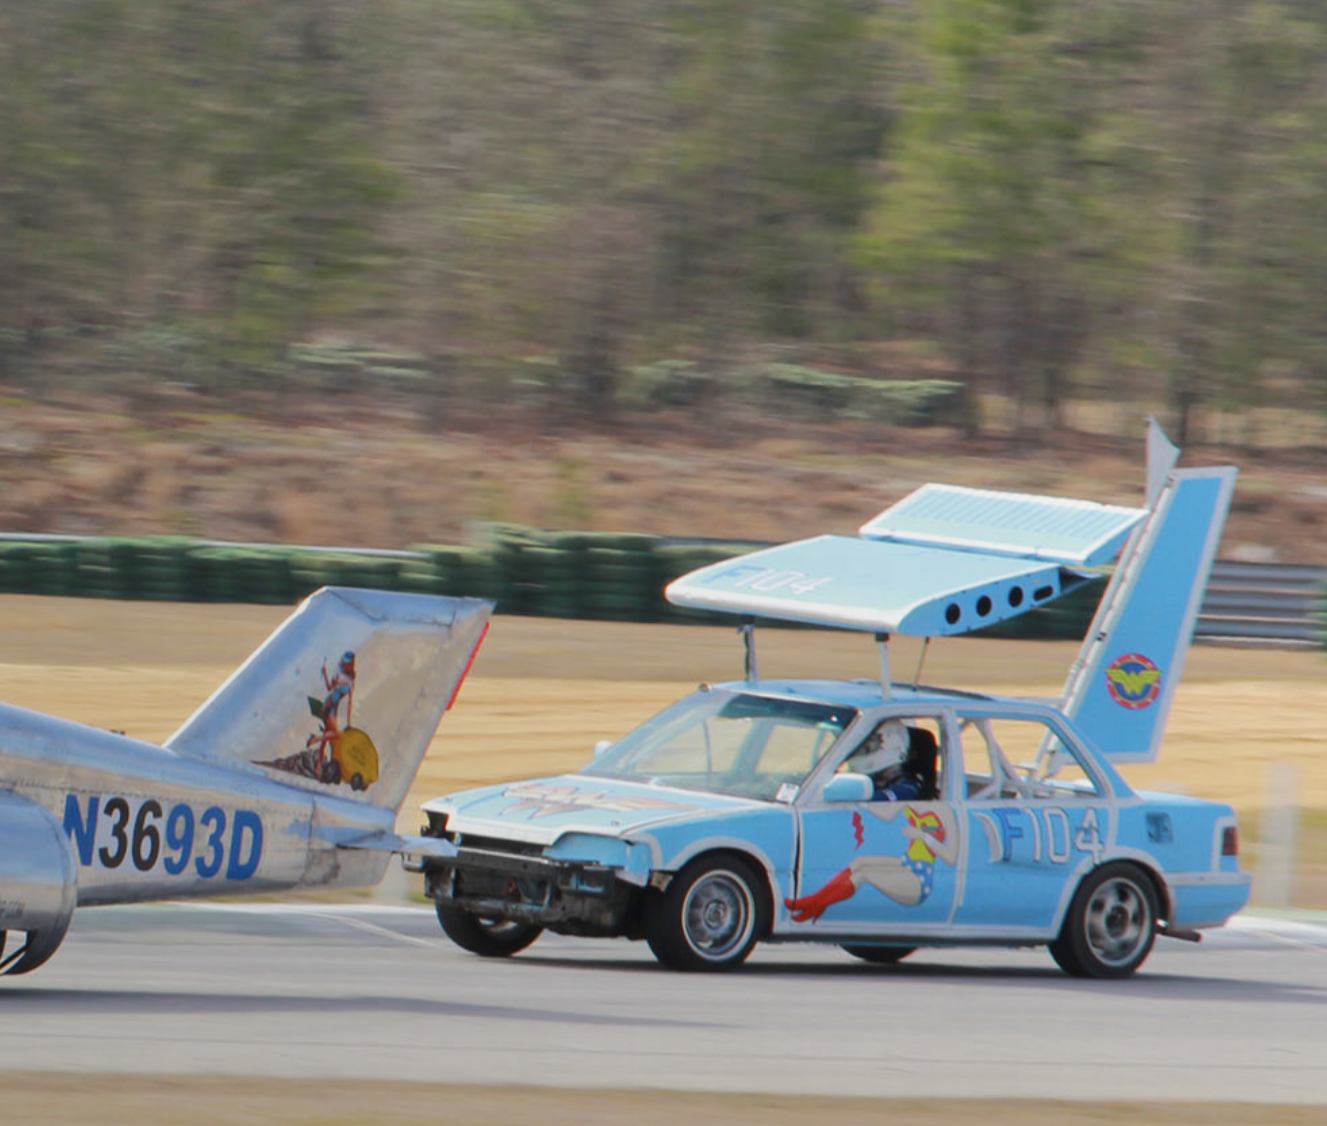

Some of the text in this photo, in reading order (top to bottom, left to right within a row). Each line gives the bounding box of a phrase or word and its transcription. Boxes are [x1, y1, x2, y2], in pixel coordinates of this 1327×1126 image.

[702, 565, 835, 595] F104
[63, 793, 264, 882] N3693D
[992, 807, 1105, 866] F104
